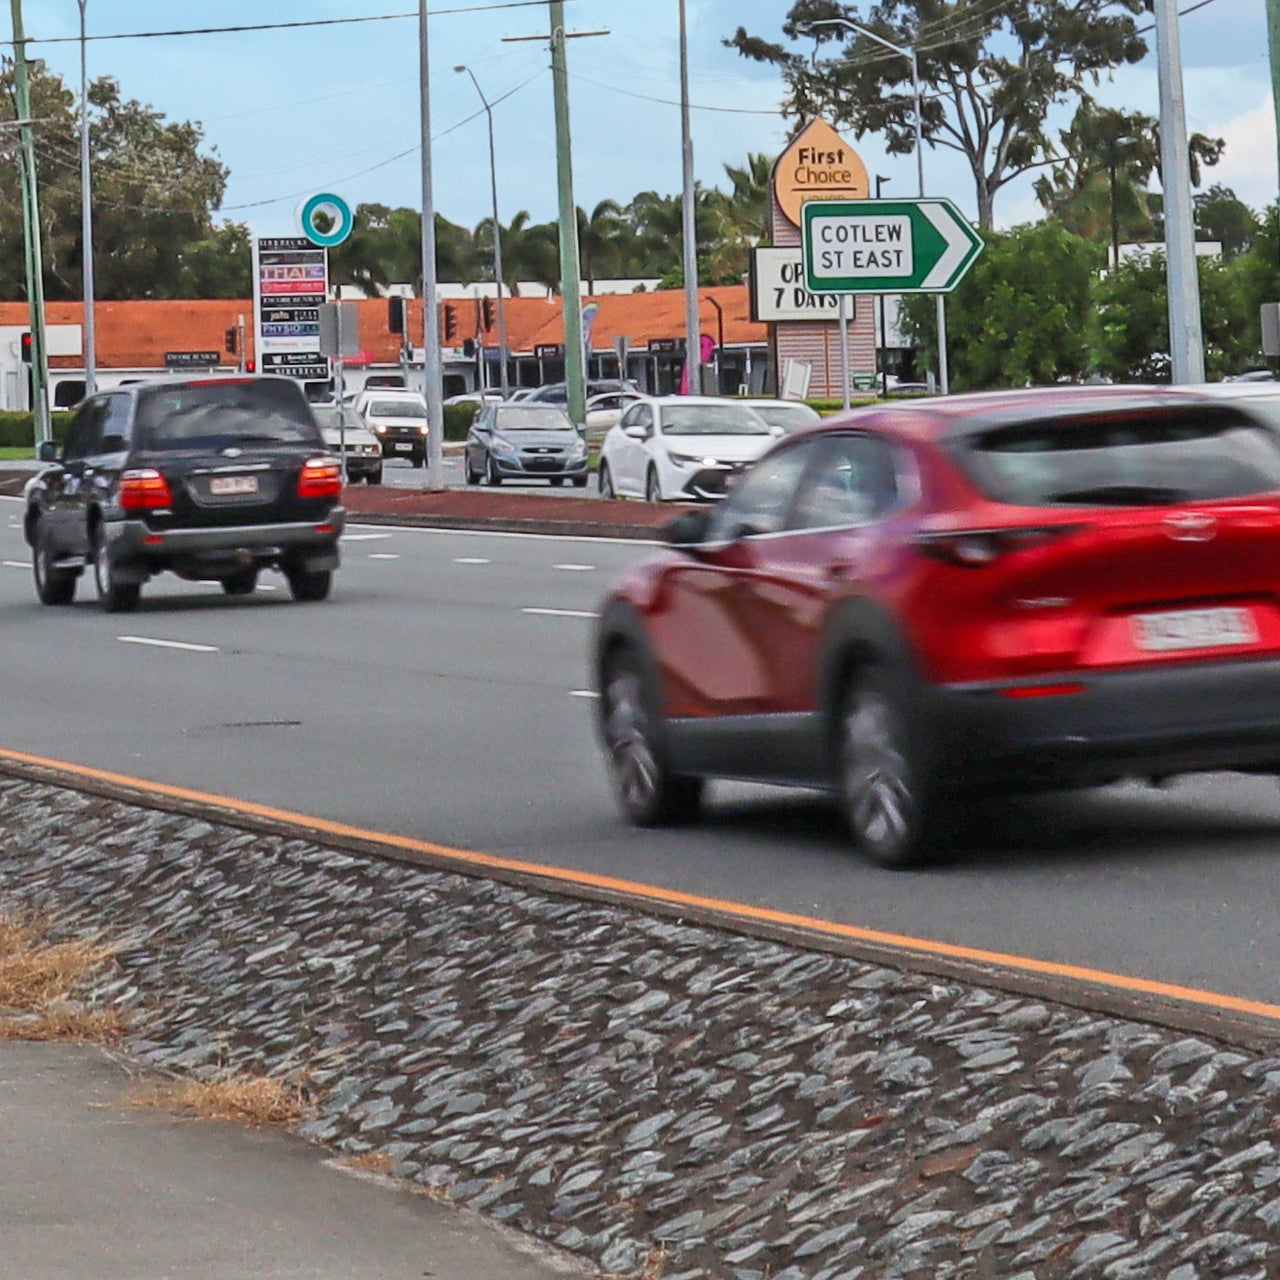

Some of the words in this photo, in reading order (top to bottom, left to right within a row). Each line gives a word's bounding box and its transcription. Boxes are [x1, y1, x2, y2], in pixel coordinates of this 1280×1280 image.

[798, 146, 845, 165] First
[794, 166, 852, 184] Choice
[821, 224, 902, 244] COTLEW
[821, 251, 844, 269] ST
[853, 250, 904, 269] EAST
[261, 267, 307, 279] THAI
[780, 263, 804, 283] OP
[773, 288, 785, 309] 7
[794, 290, 838, 308] DAYS
